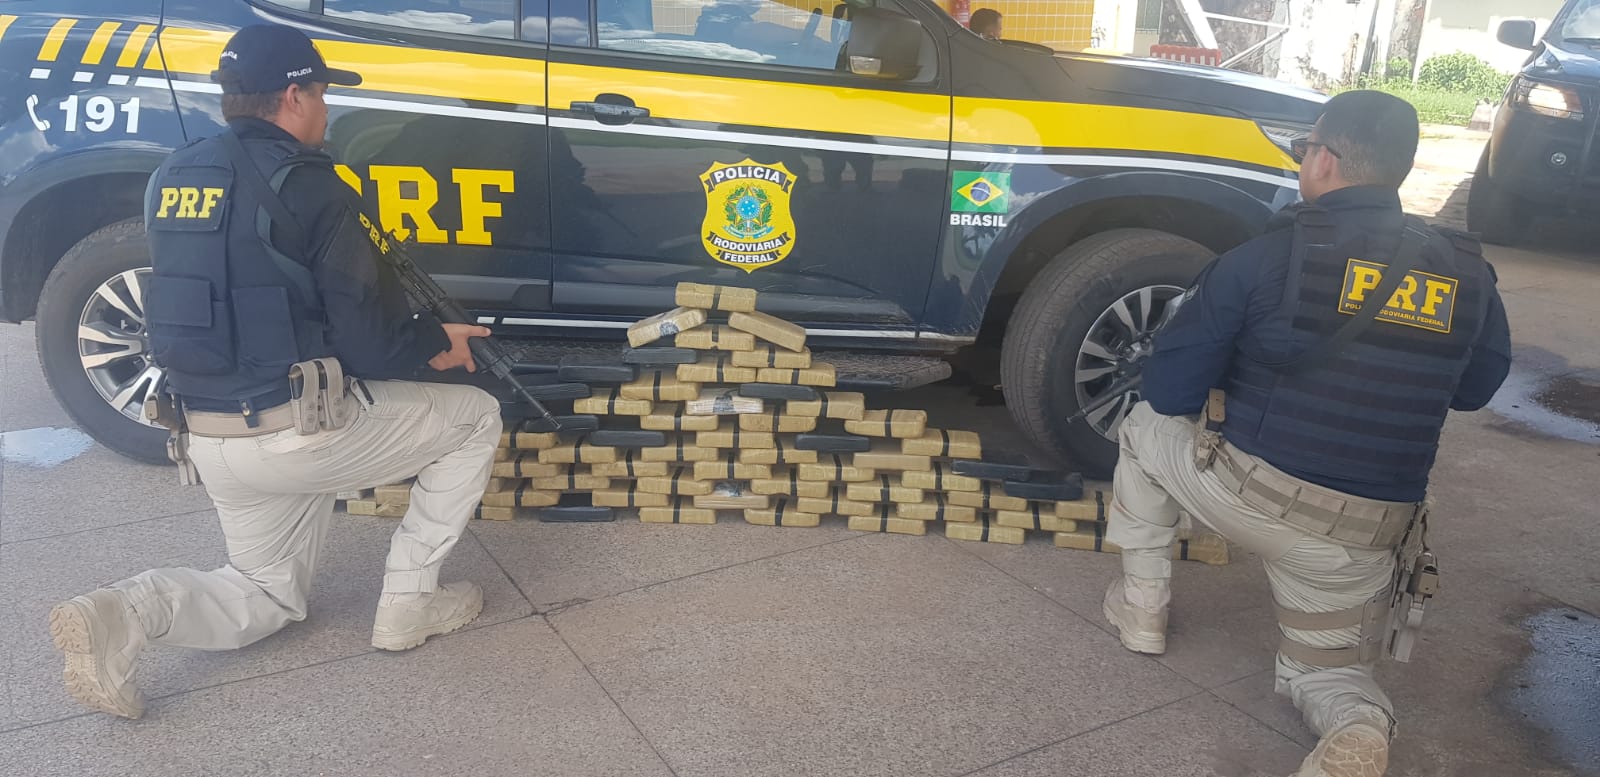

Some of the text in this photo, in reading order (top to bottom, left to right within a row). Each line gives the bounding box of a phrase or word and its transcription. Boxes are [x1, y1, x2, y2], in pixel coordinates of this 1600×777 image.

[59, 94, 140, 134] 191
[713, 166, 781, 183] POLÍCIA
[155, 187, 225, 219] PRF
[333, 164, 515, 246] RF
[950, 213, 1008, 227] BRASIL
[359, 212, 391, 255] PRF
[724, 252, 774, 263] FEDERAL
[1347, 265, 1452, 316] PRF
